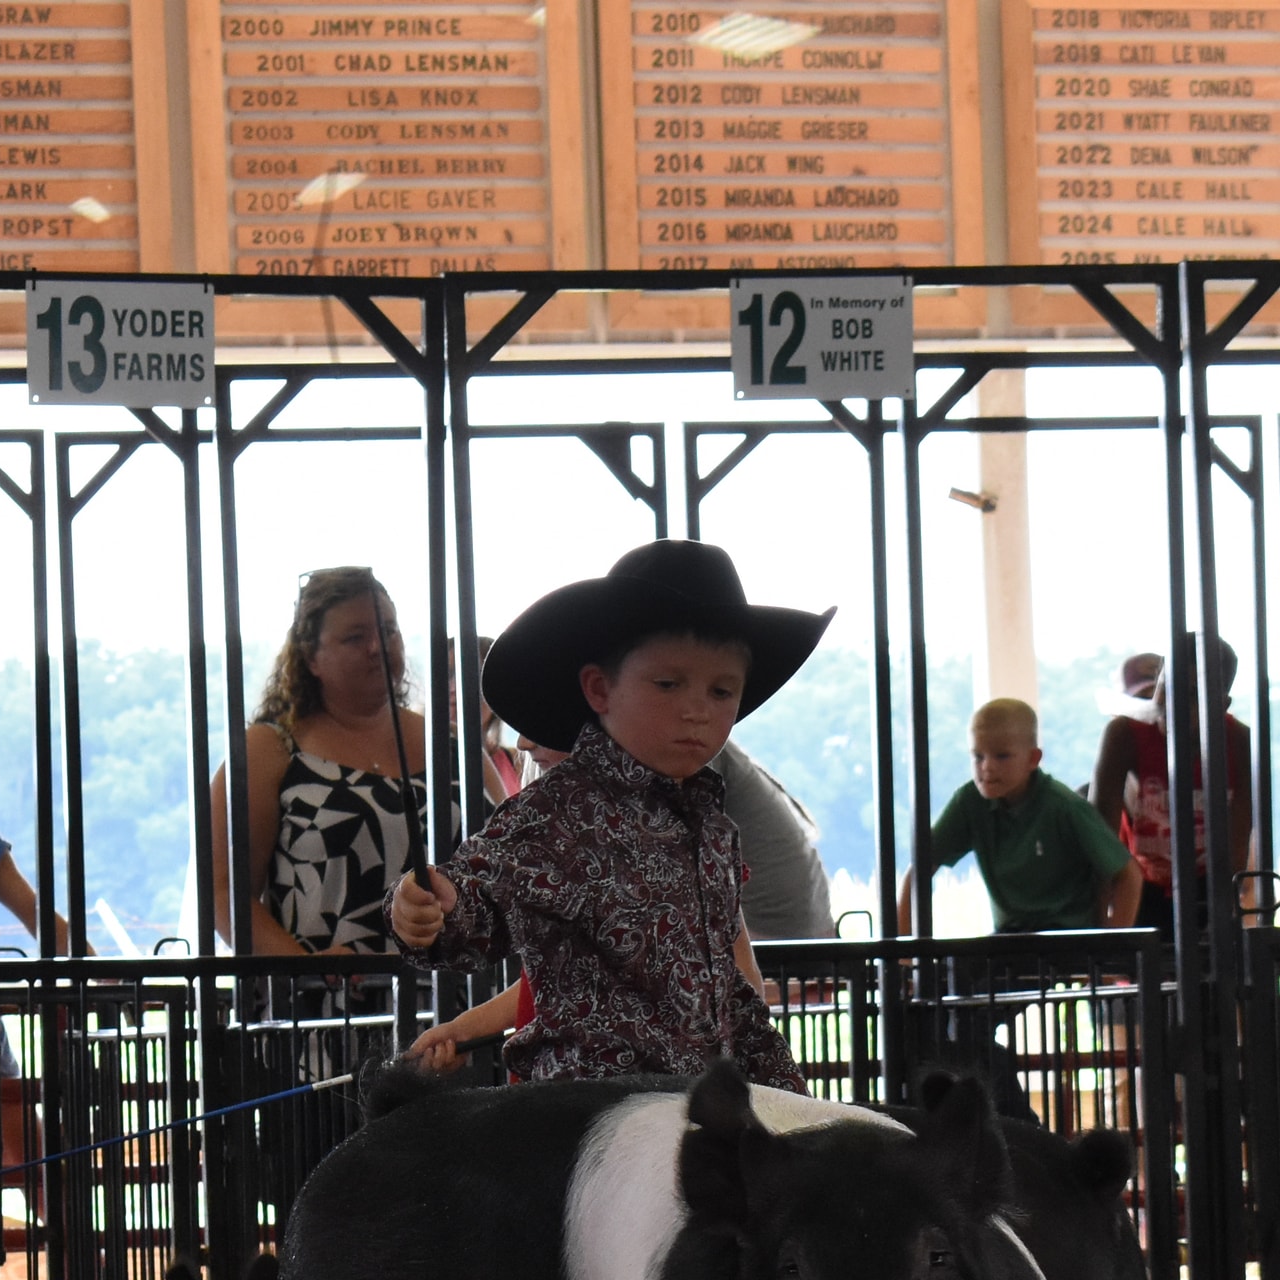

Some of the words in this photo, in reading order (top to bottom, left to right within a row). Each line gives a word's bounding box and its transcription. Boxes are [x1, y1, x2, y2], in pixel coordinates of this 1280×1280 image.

[230, 19, 284, 36] 2000
[309, 19, 373, 36] JIMMY
[385, 19, 461, 36] PRINCE
[652, 15, 699, 32] 2010
[1052, 10, 1099, 28] 2018
[1210, 11, 1266, 29] RIPLEY
[257, 55, 304, 72] 2001
[335, 55, 391, 72] CHAD
[405, 55, 508, 72] LENSMAN
[652, 50, 693, 69] 2011
[1054, 46, 1101, 63] 2019
[653, 86, 702, 103] 2012
[721, 87, 761, 105] CODY
[782, 87, 860, 105] LENSMAN
[1056, 78, 1110, 96] 2020
[242, 90, 298, 106] 2002
[347, 90, 398, 106] LISA
[422, 90, 478, 106] KNOX
[655, 121, 704, 139] 2013
[724, 121, 781, 139] MAGGIE
[1056, 113, 1103, 131] 2021
[1123, 113, 1170, 131] WYATT
[1190, 113, 1269, 131] FAULKNER
[243, 126, 293, 140] 2003
[327, 124, 379, 140] CODY
[400, 124, 509, 140] LENSMAN
[655, 155, 703, 173] 2014
[724, 155, 765, 173] JACK
[787, 155, 824, 173] WING
[1057, 146, 1111, 164] 2022
[1192, 147, 1249, 165] WILSON
[246, 159, 298, 174] 2004
[436, 159, 506, 174] BERRY
[657, 189, 707, 208] 2015
[1059, 181, 1112, 198] 2023
[1136, 181, 1182, 199] CALE
[1206, 181, 1251, 199] HALL
[353, 191, 410, 209] LACIE
[428, 191, 496, 209] GAVER
[658, 223, 706, 241] 2016
[1059, 216, 1112, 233] 2024
[1138, 217, 1185, 235] CALE
[1204, 217, 1252, 235] HALL
[252, 230, 304, 245] 2006
[332, 228, 386, 243] JOEY
[399, 226, 477, 242] BROWN
[256, 260, 313, 276] 2007
[811, 298, 823, 308] In
[829, 298, 885, 311] Memory
[891, 296, 904, 307] of
[113, 309, 204, 337] YODER
[832, 319, 873, 339] BOB
[37, 296, 107, 394] 13
[739, 291, 806, 385] 12
[114, 353, 204, 382] FARMS
[822, 351, 884, 371] WHITE
